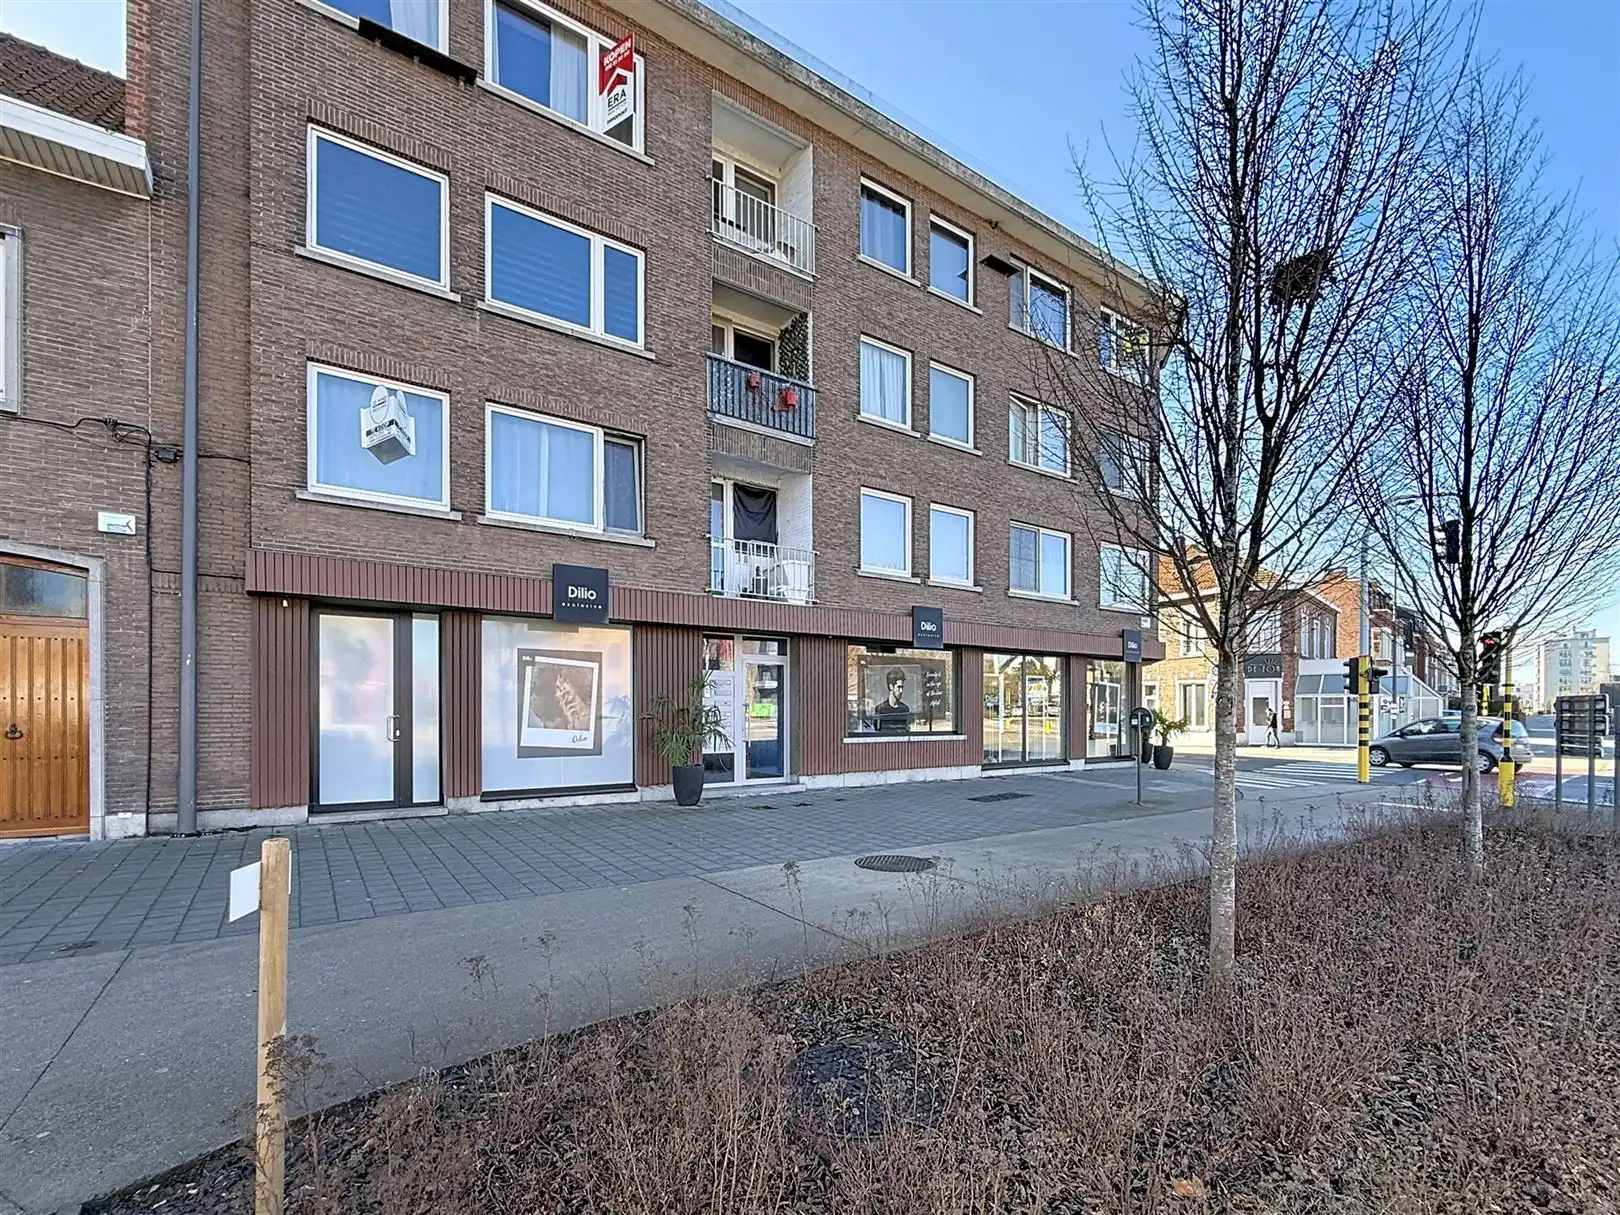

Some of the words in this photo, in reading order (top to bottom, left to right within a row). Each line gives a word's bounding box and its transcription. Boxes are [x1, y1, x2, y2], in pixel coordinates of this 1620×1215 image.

[603, 38, 632, 66] KOPEN
[608, 88, 627, 108] ERA
[568, 585, 597, 600] Dilio
[920, 621, 937, 631] Dilio
